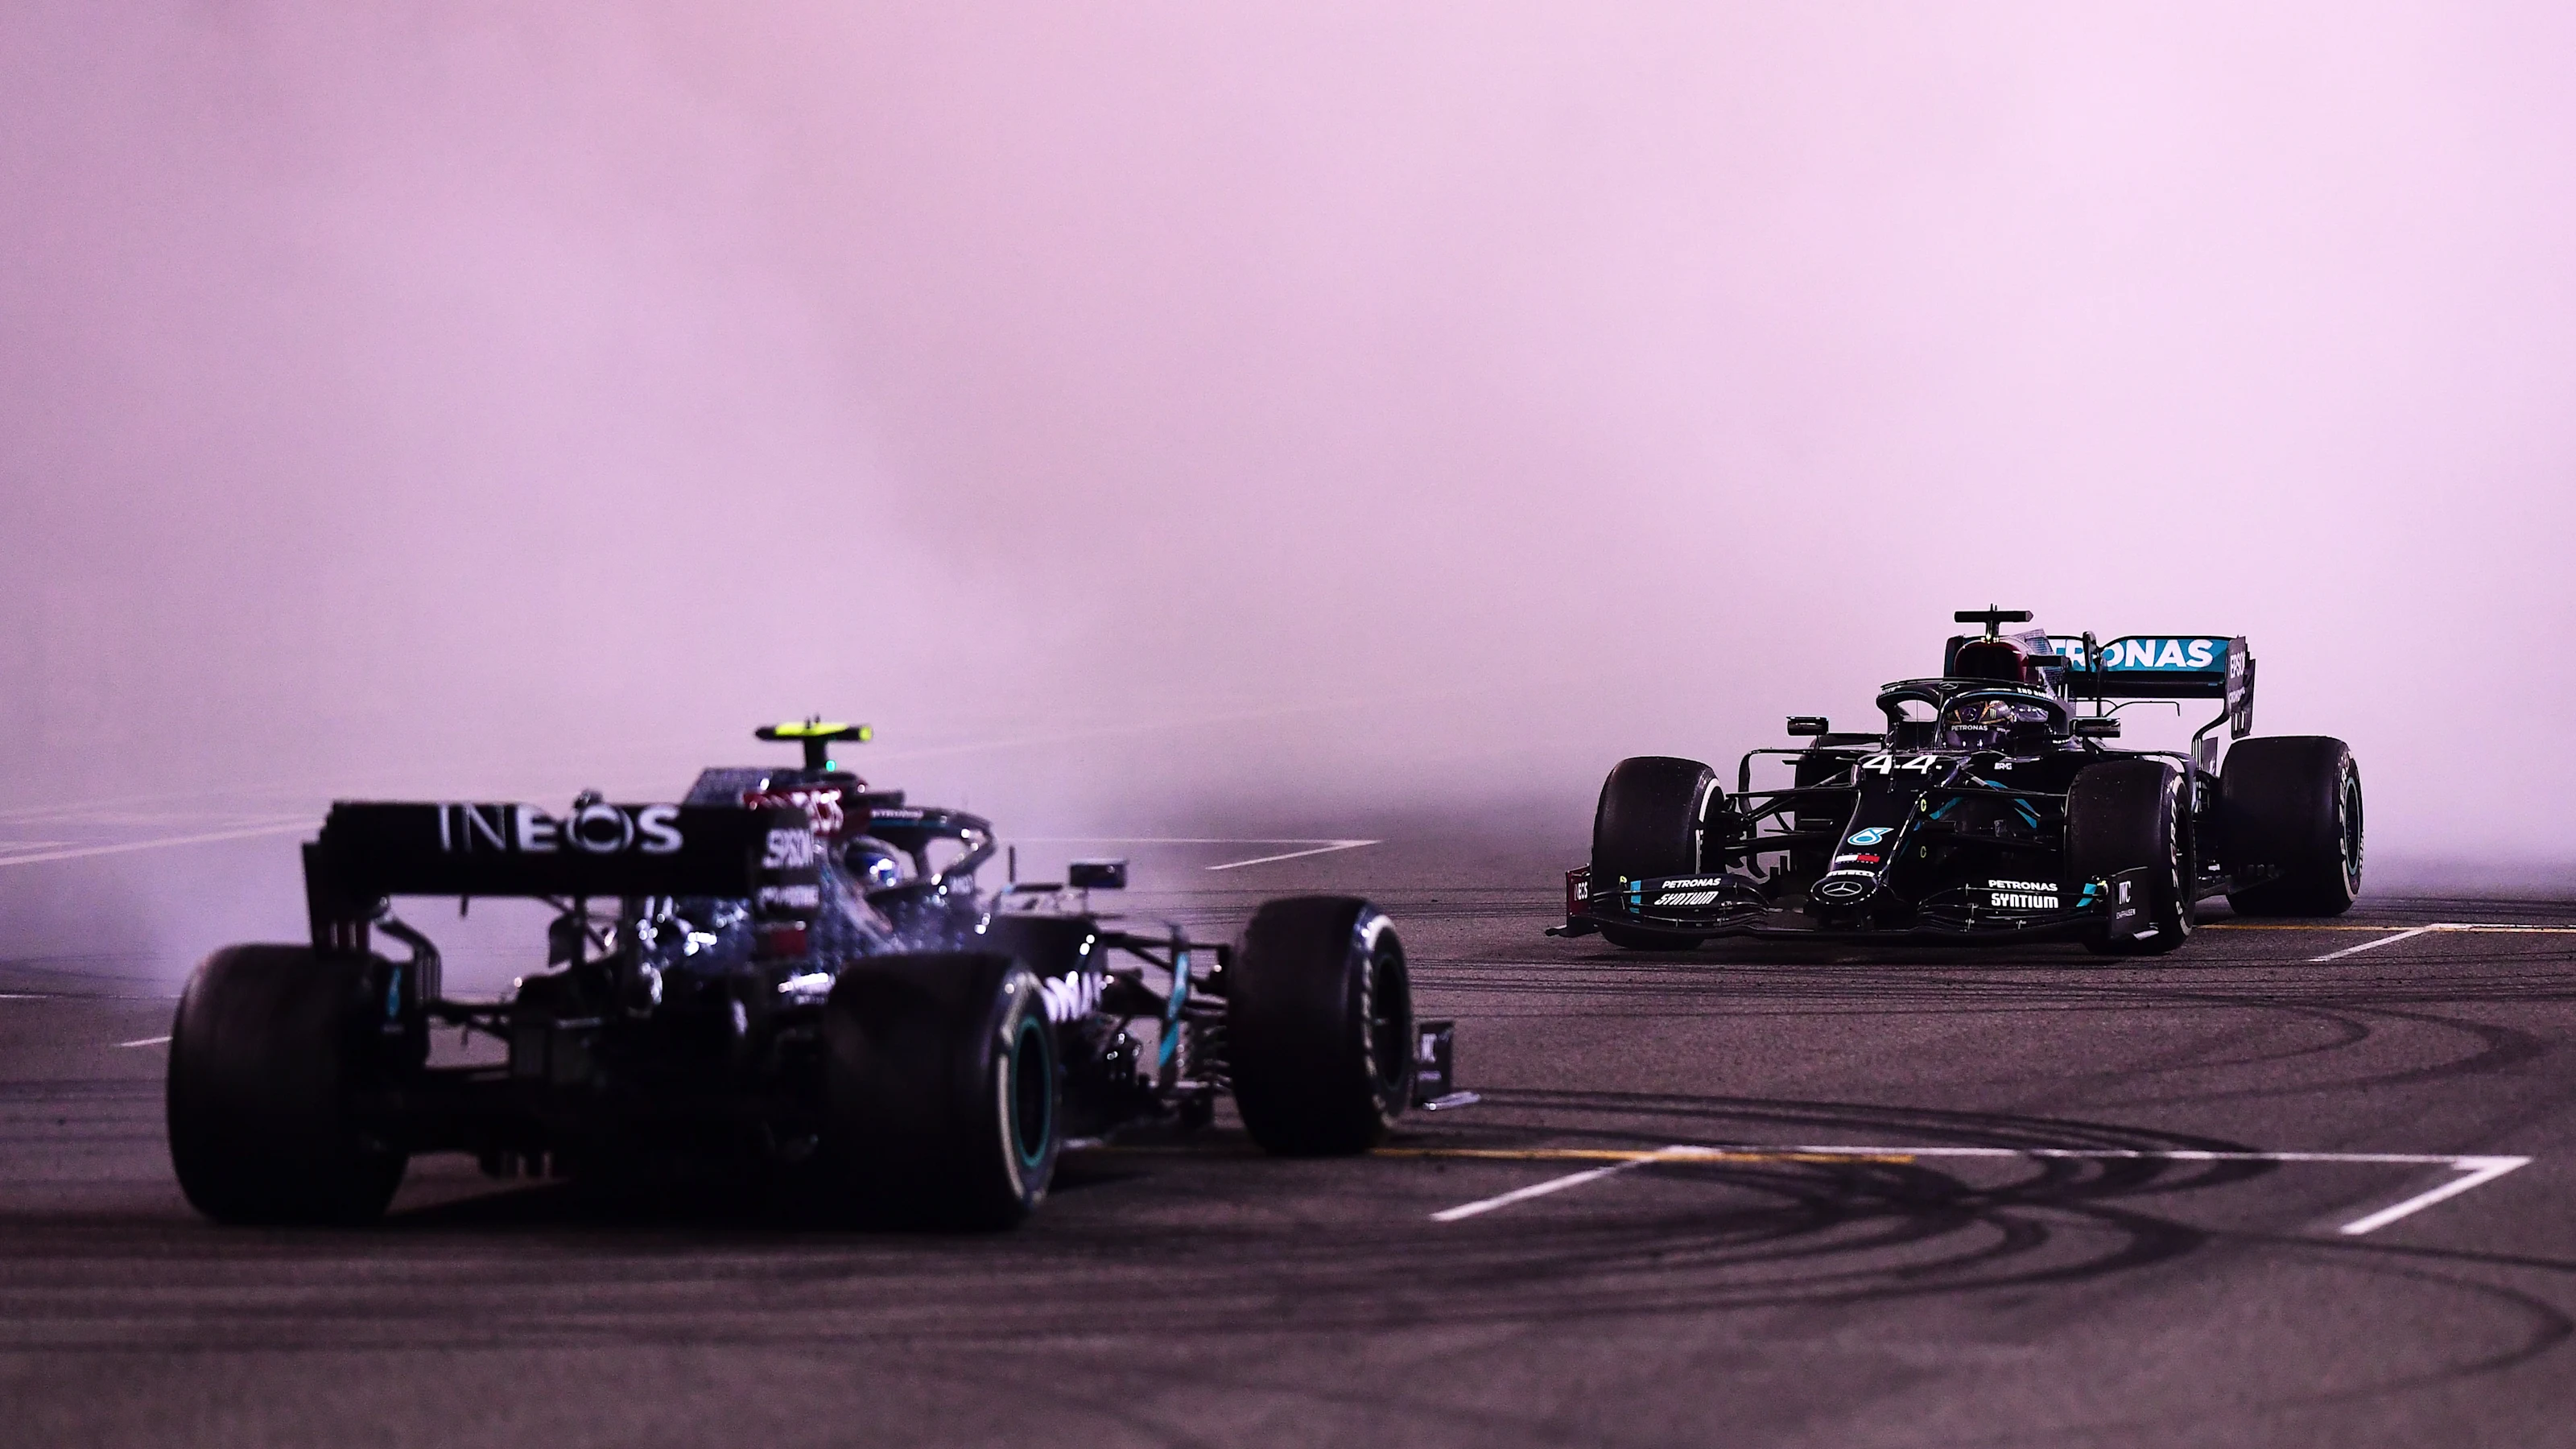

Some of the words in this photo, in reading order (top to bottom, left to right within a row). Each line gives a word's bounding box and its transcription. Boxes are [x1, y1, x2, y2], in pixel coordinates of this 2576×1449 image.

[2230, 651, 2245, 679] EPSO
[1862, 755, 1942, 774] 44
[440, 803, 683, 854] INEOS
[1662, 878, 1722, 889] PETRONAS
[1988, 880, 2058, 891] PETRONAS
[1654, 891, 1719, 906] SYNTIUM
[1992, 893, 2059, 908] SYNTIUM
